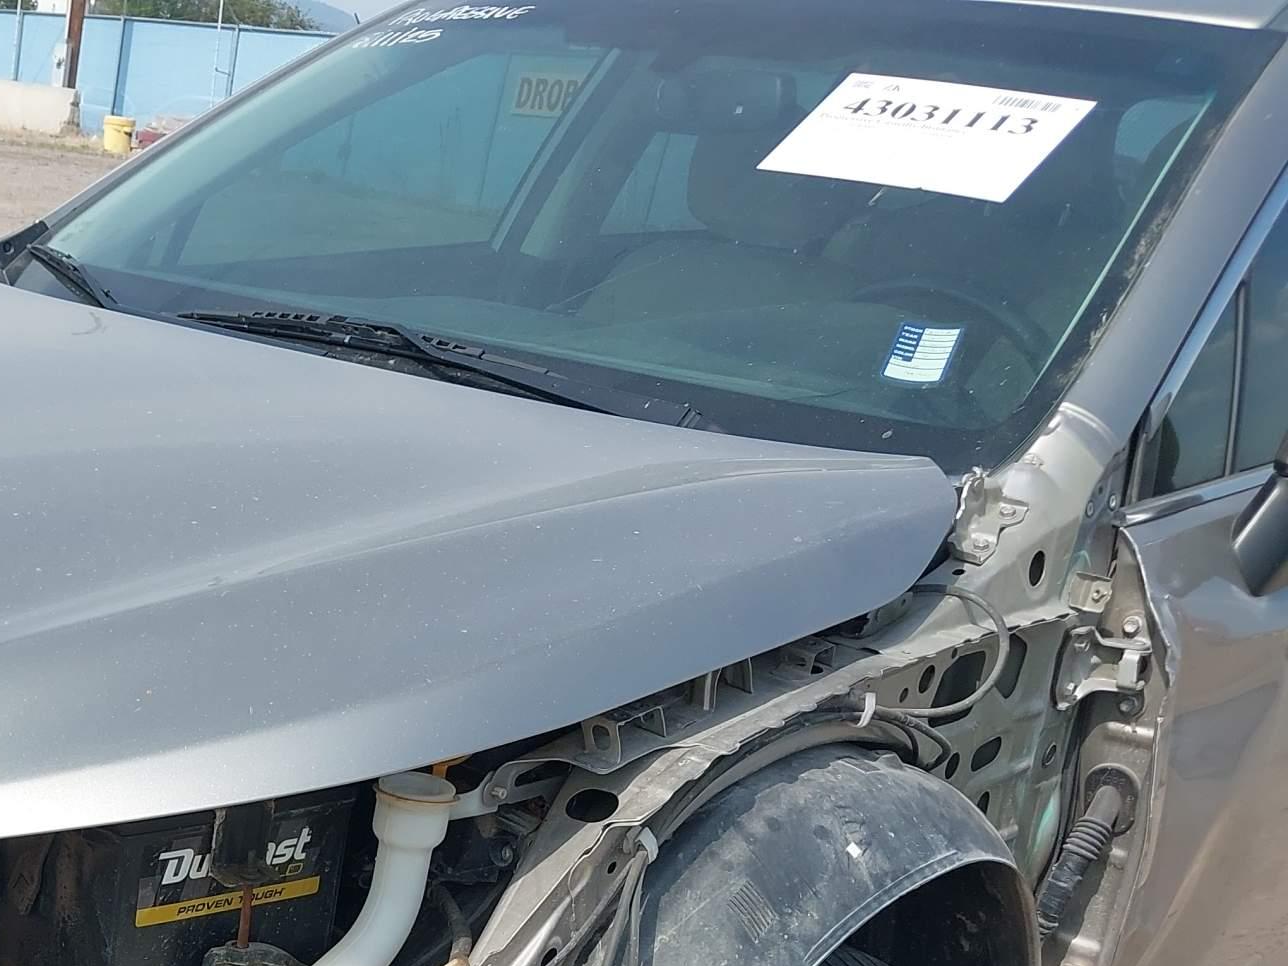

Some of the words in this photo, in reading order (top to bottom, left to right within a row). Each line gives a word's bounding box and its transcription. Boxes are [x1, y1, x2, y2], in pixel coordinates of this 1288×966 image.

[843, 97, 1038, 135] 43031113
[159, 827, 311, 886] Dust
[177, 897, 234, 916] PROVEN
